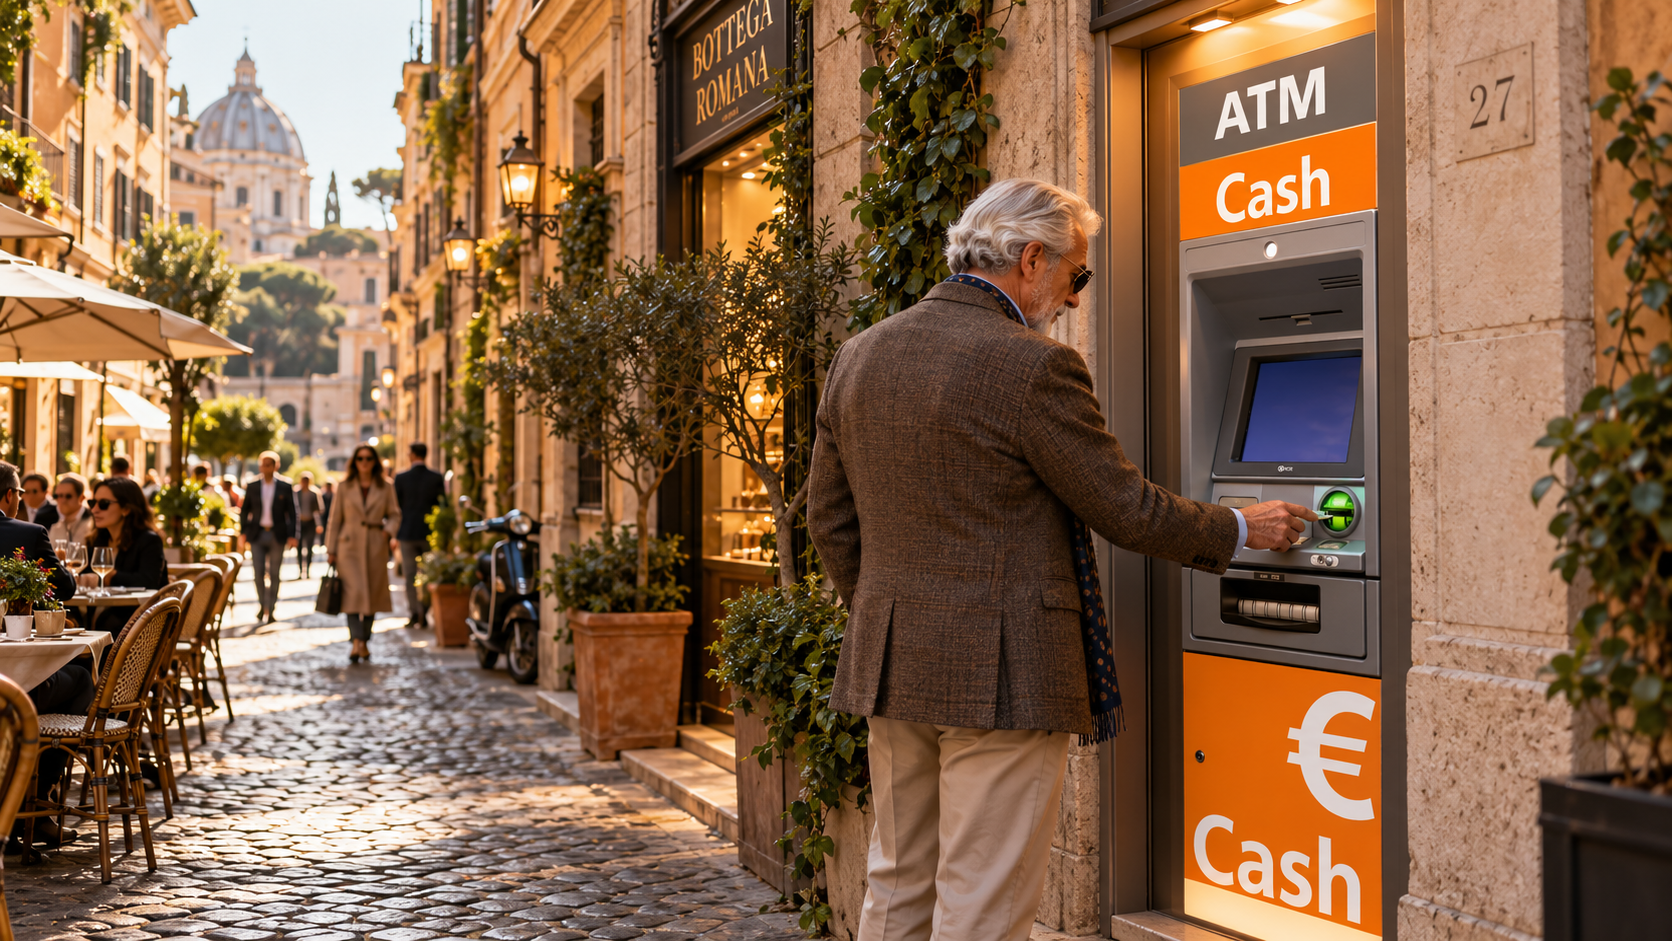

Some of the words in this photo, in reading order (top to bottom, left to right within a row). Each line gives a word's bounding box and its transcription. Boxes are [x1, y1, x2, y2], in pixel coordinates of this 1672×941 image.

[692, 0, 774, 81] BOTTEGA
[695, 44, 770, 126] ROMANA
[1214, 65, 1327, 141] ATM
[1469, 75, 1515, 130] 27
[1216, 154, 1331, 224] Cash
[1286, 690, 1376, 821] €
[1193, 814, 1362, 925] Cash
